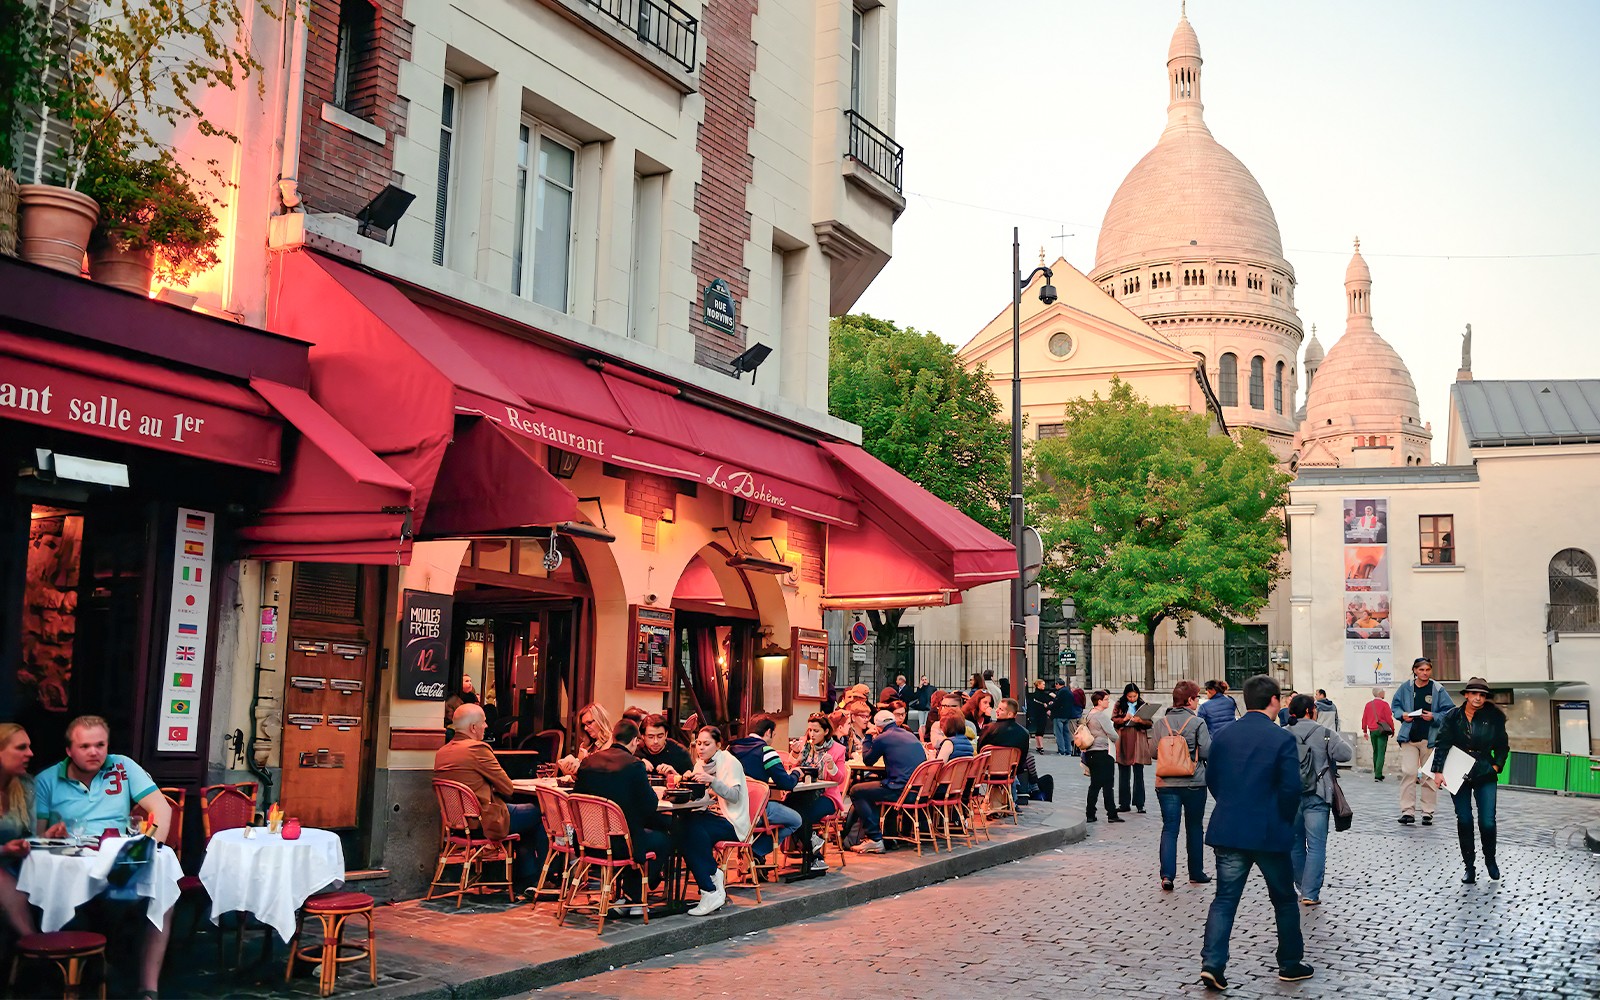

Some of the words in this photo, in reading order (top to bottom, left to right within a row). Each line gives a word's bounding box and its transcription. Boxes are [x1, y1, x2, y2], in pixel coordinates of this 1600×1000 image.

[714, 299, 727, 312] RUE
[0, 382, 52, 415] ant
[68, 396, 131, 431] salle
[138, 415, 163, 438] au
[504, 406, 605, 456] Restaurant
[706, 464, 727, 489] La
[728, 471, 787, 507] Bohème
[410, 607, 441, 623] MOULES
[103, 770, 123, 796] 3
